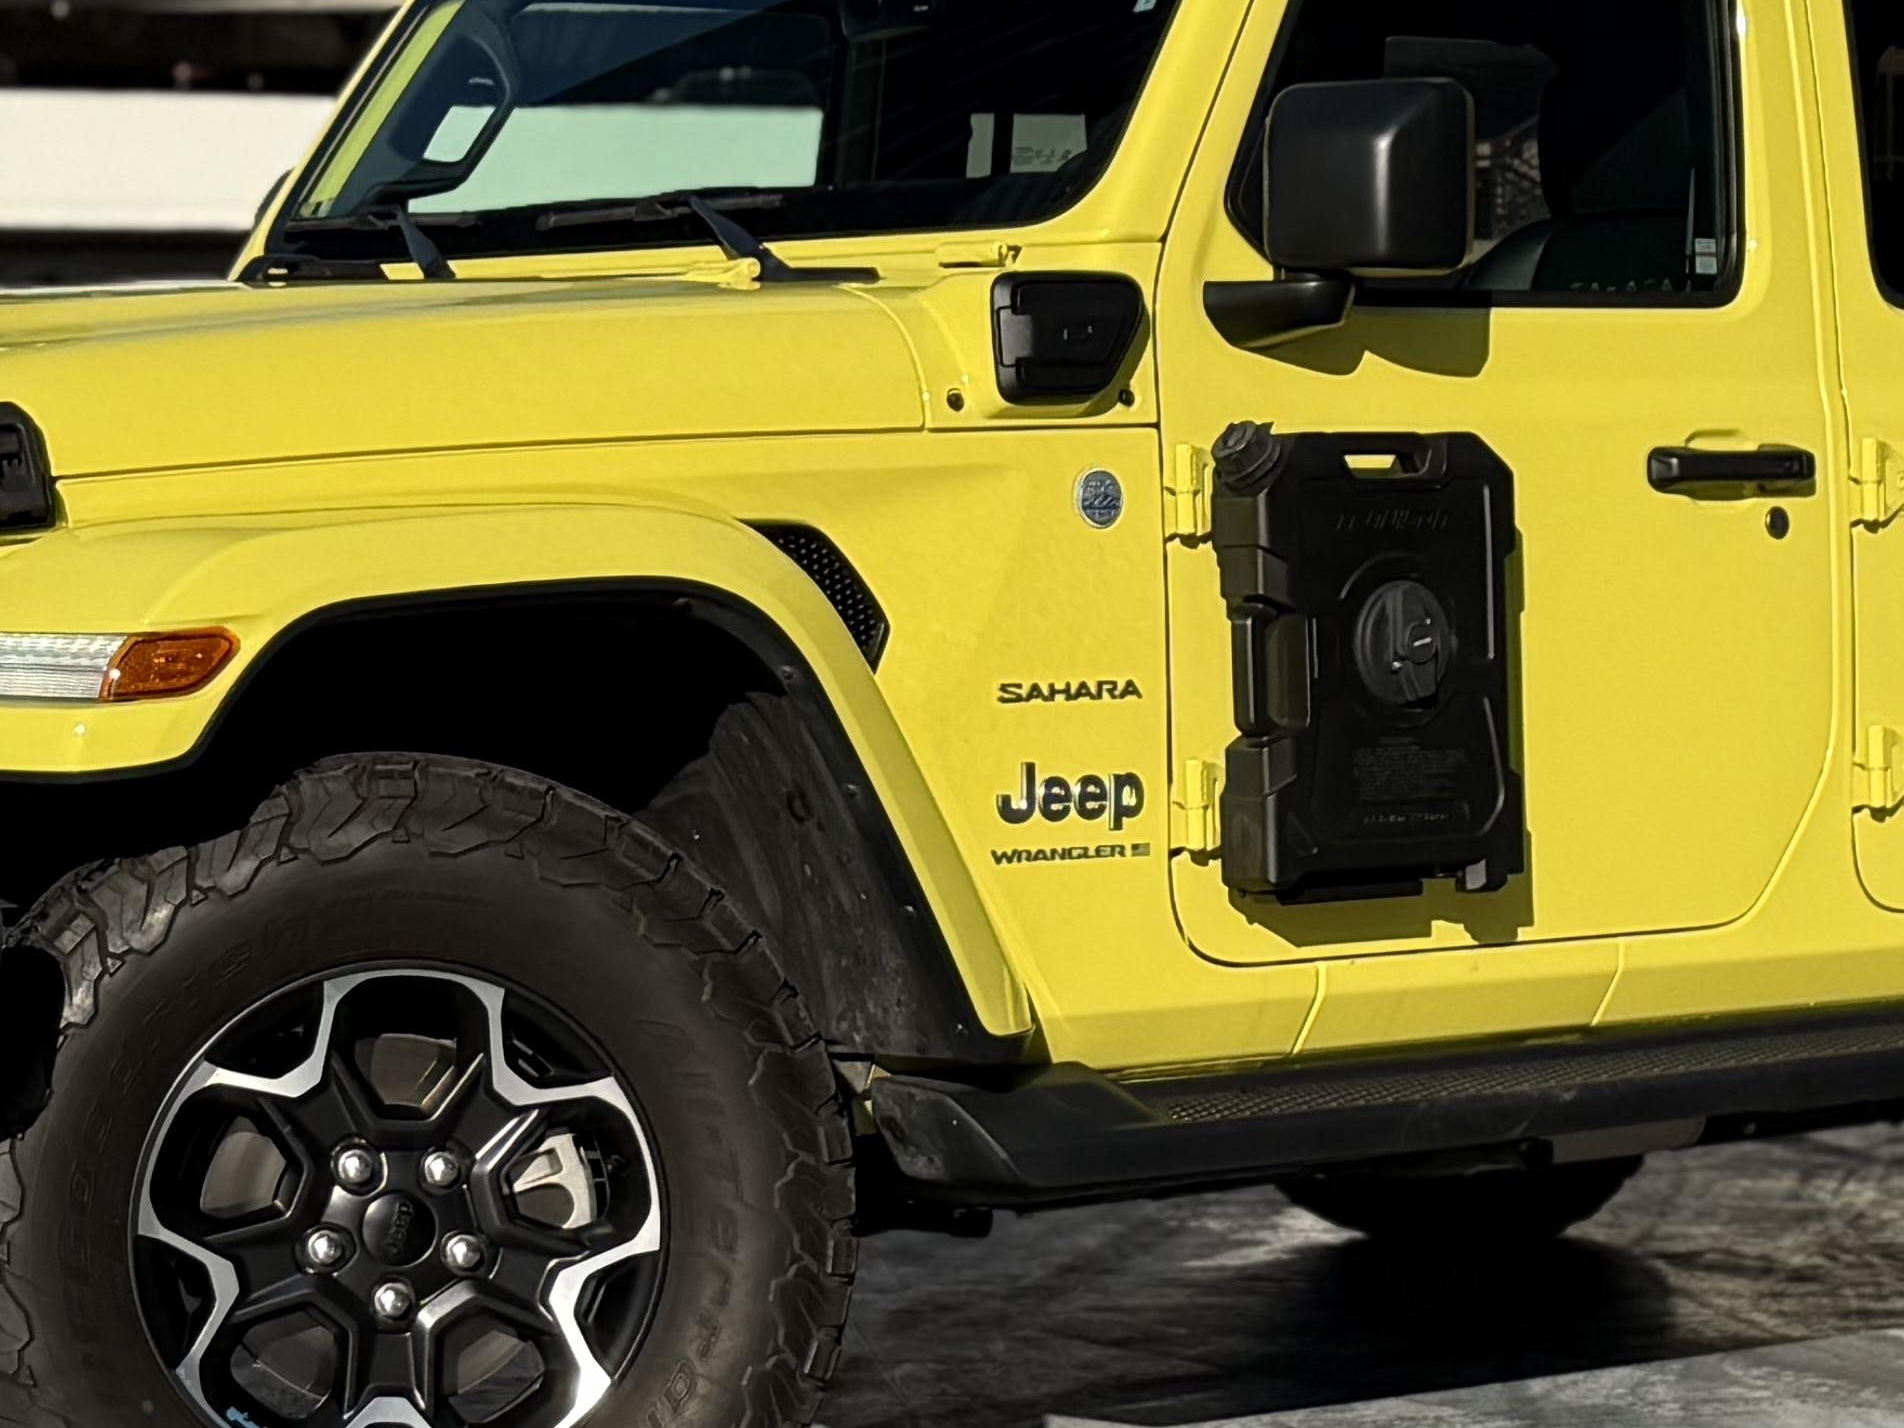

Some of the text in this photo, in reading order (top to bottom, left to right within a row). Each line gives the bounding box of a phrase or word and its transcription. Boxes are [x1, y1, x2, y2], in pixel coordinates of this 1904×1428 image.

[996, 679, 1143, 704] SAHARA
[996, 761, 1145, 831] Jeep
[990, 844, 1127, 866] WRANGLER
[384, 1201, 415, 1255] Jeep
